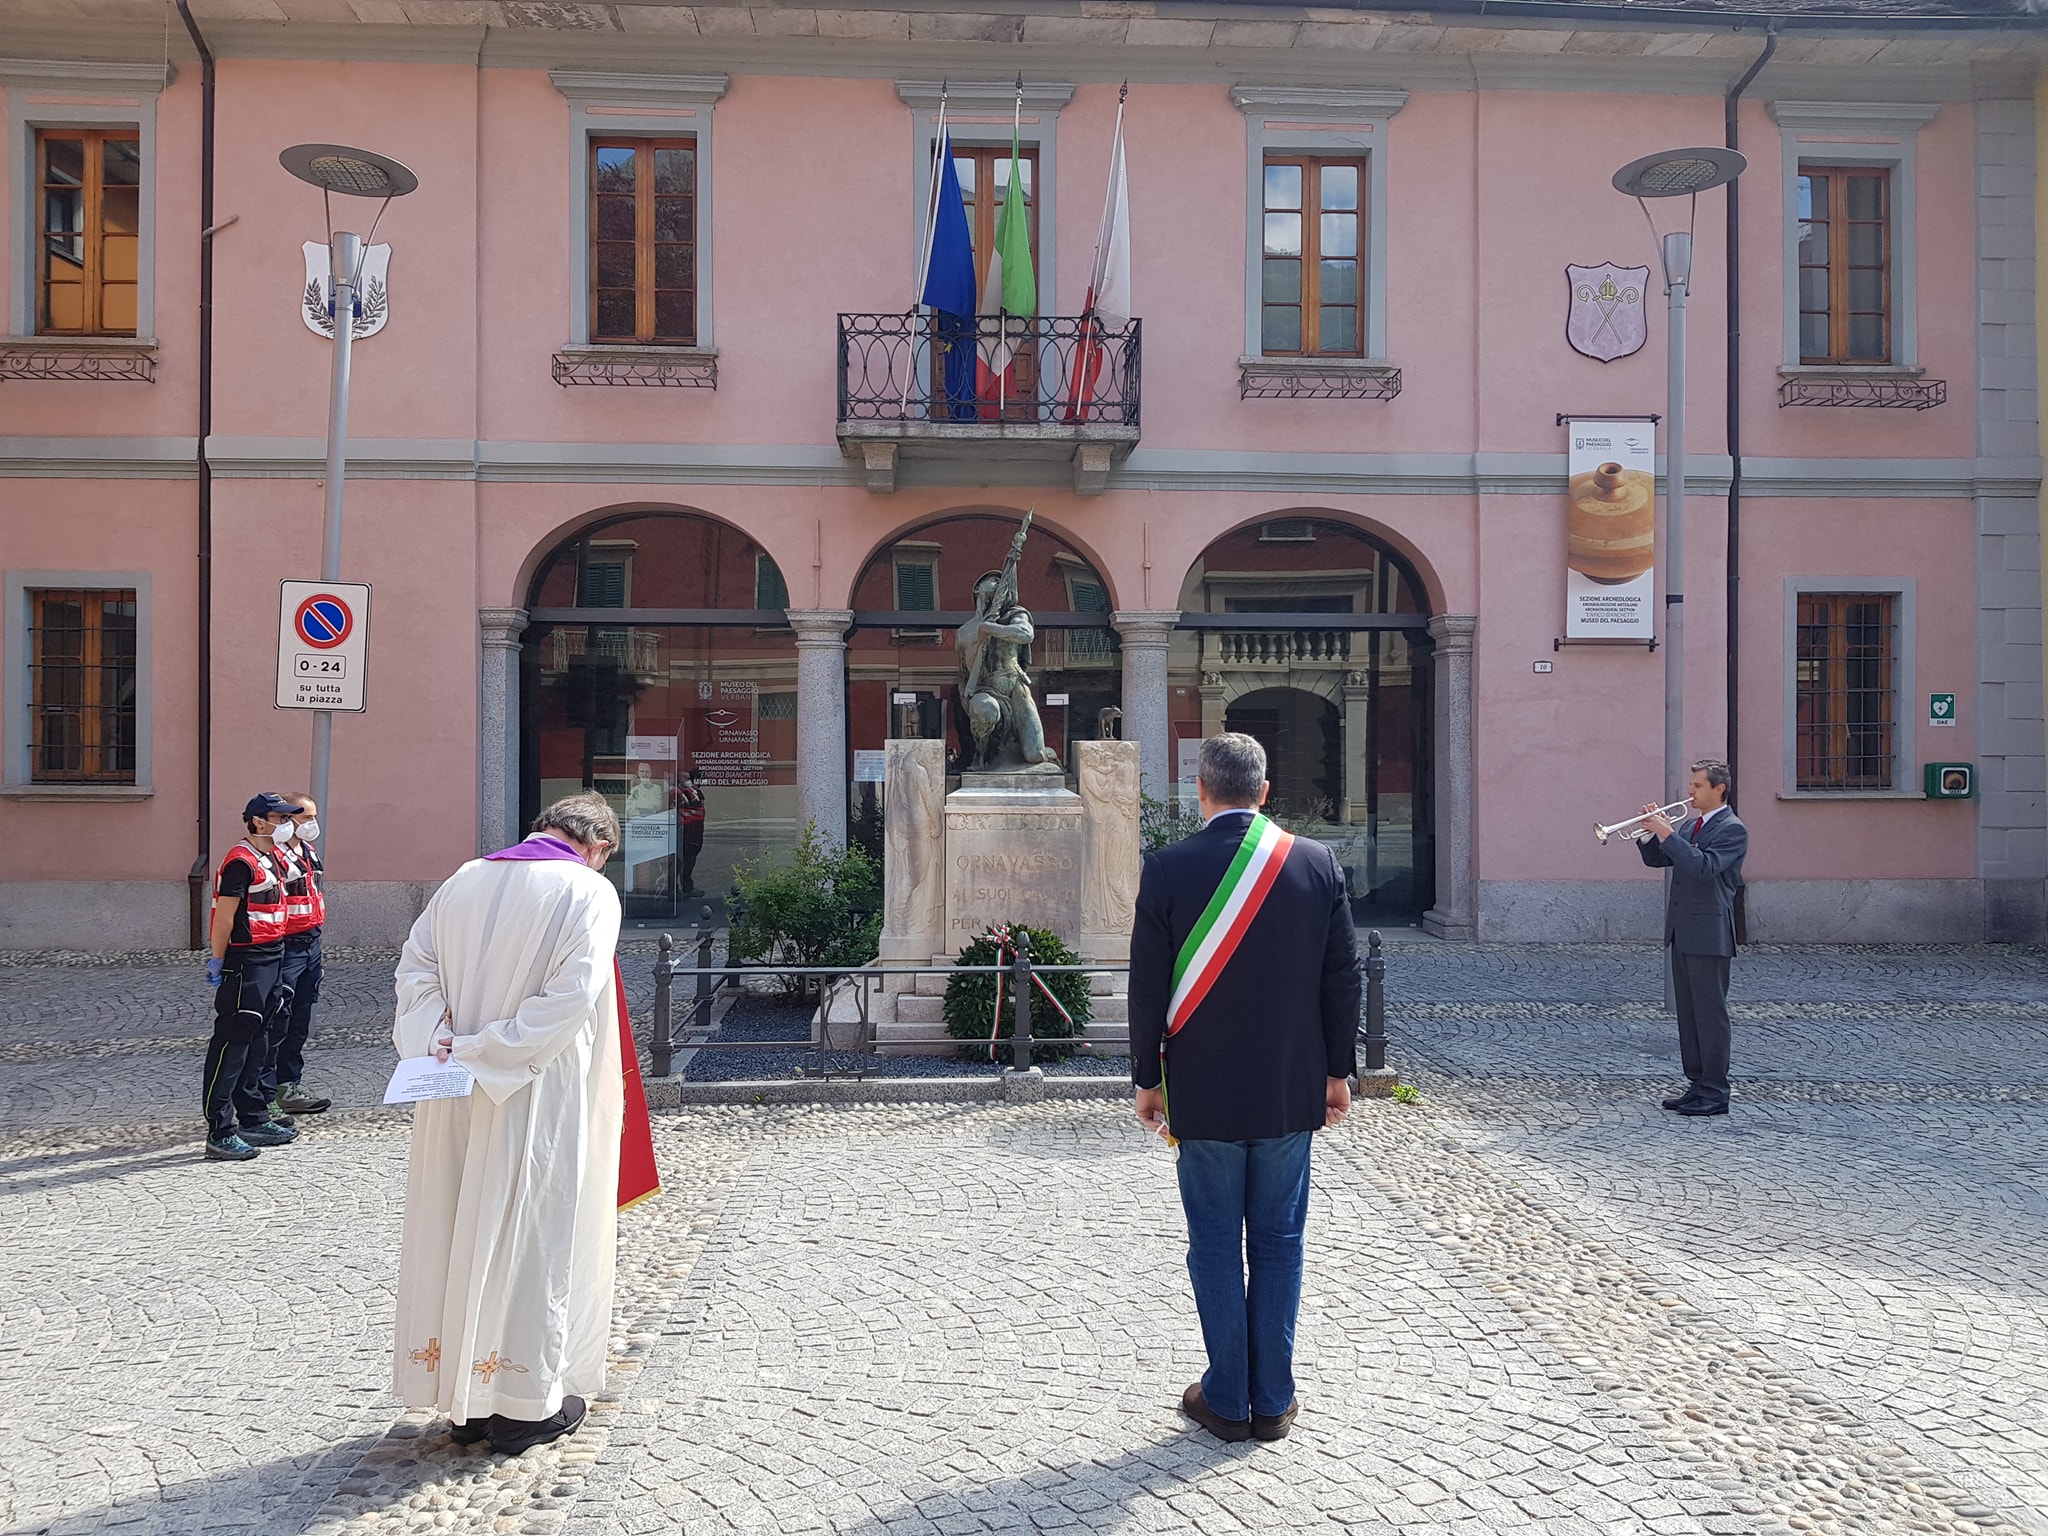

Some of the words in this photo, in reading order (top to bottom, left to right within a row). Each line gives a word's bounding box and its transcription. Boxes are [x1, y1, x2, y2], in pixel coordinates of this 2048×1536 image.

[299, 684, 312, 692] su
[316, 683, 341, 693] tutta
[296, 693, 305, 702] la
[309, 694, 343, 704] piazza
[691, 751, 720, 759] SEZIONE
[720, 751, 771, 759] ARCHEOLOGICA
[731, 778, 769, 786] PAESAGGIO
[956, 854, 1073, 871] ORNAVASSO
[976, 887, 1011, 901] SUOI
[951, 918, 982, 930] PER
